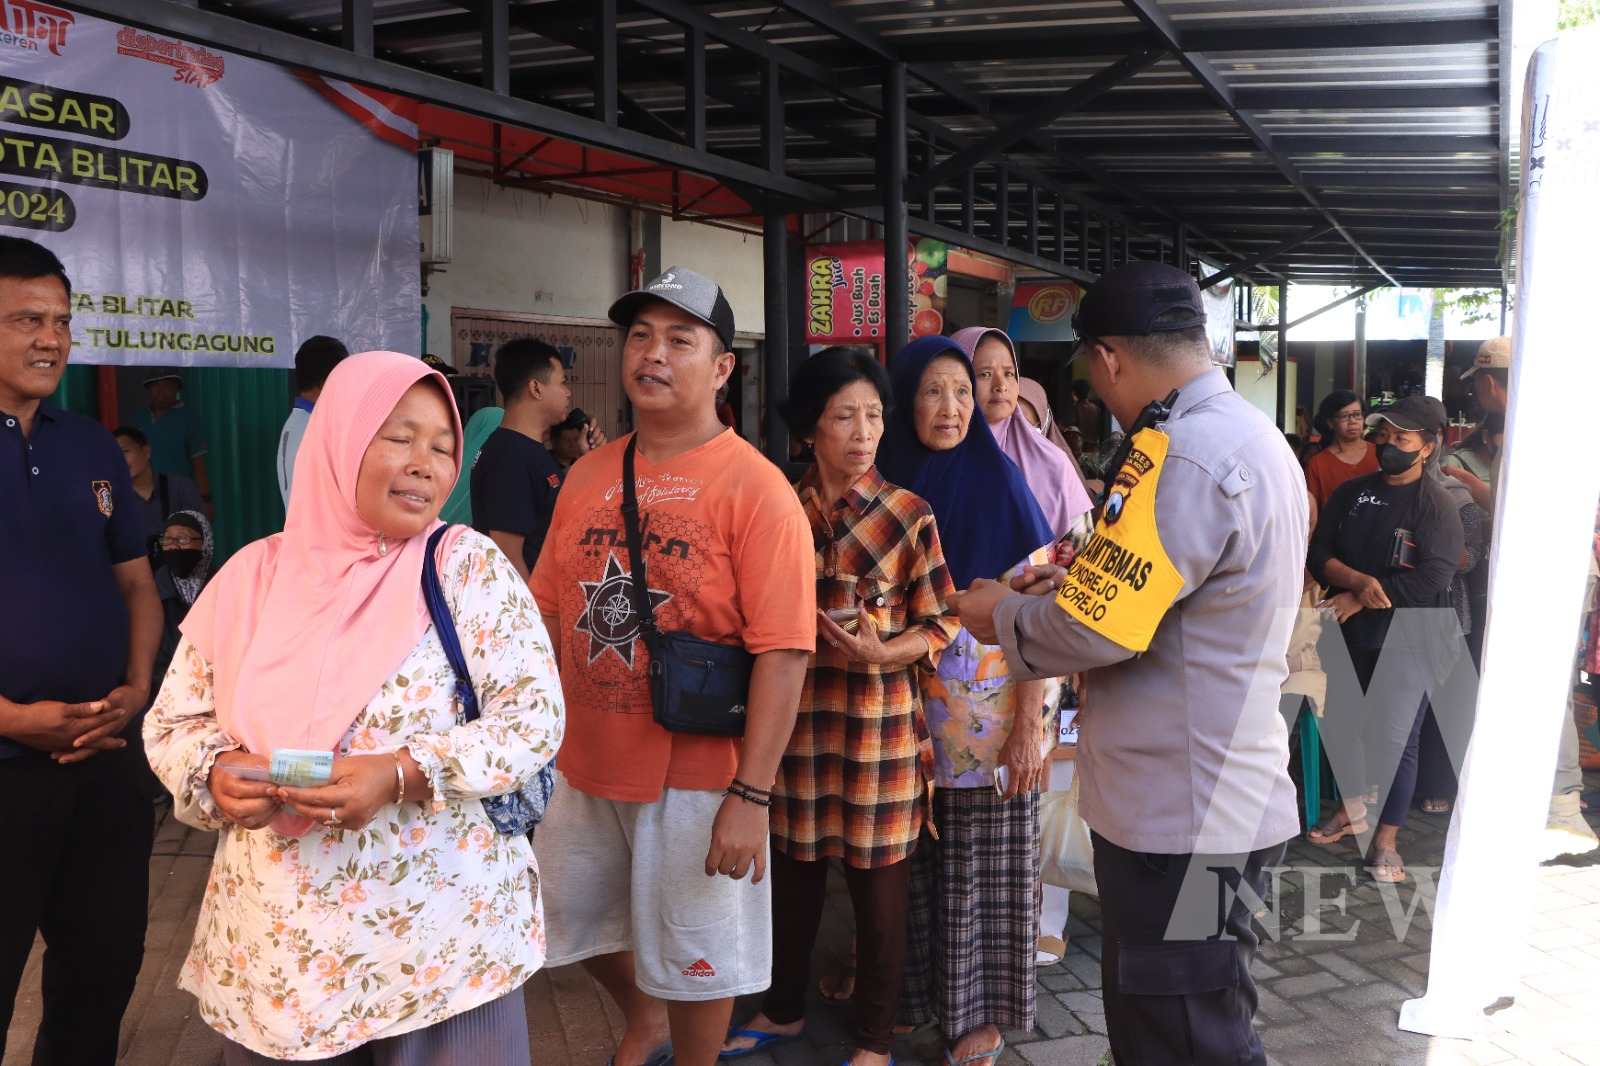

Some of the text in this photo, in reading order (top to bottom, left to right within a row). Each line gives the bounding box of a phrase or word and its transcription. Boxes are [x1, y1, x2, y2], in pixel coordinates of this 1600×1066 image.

[72, 147, 200, 194] BLITAR
[102, 295, 194, 318] BLITAR
[809, 256, 834, 336] ZAHRA
[851, 268, 864, 326] Jus Buah
[868, 275, 880, 324] Es Buah
[86, 327, 275, 354] TULUNGAGUNG
